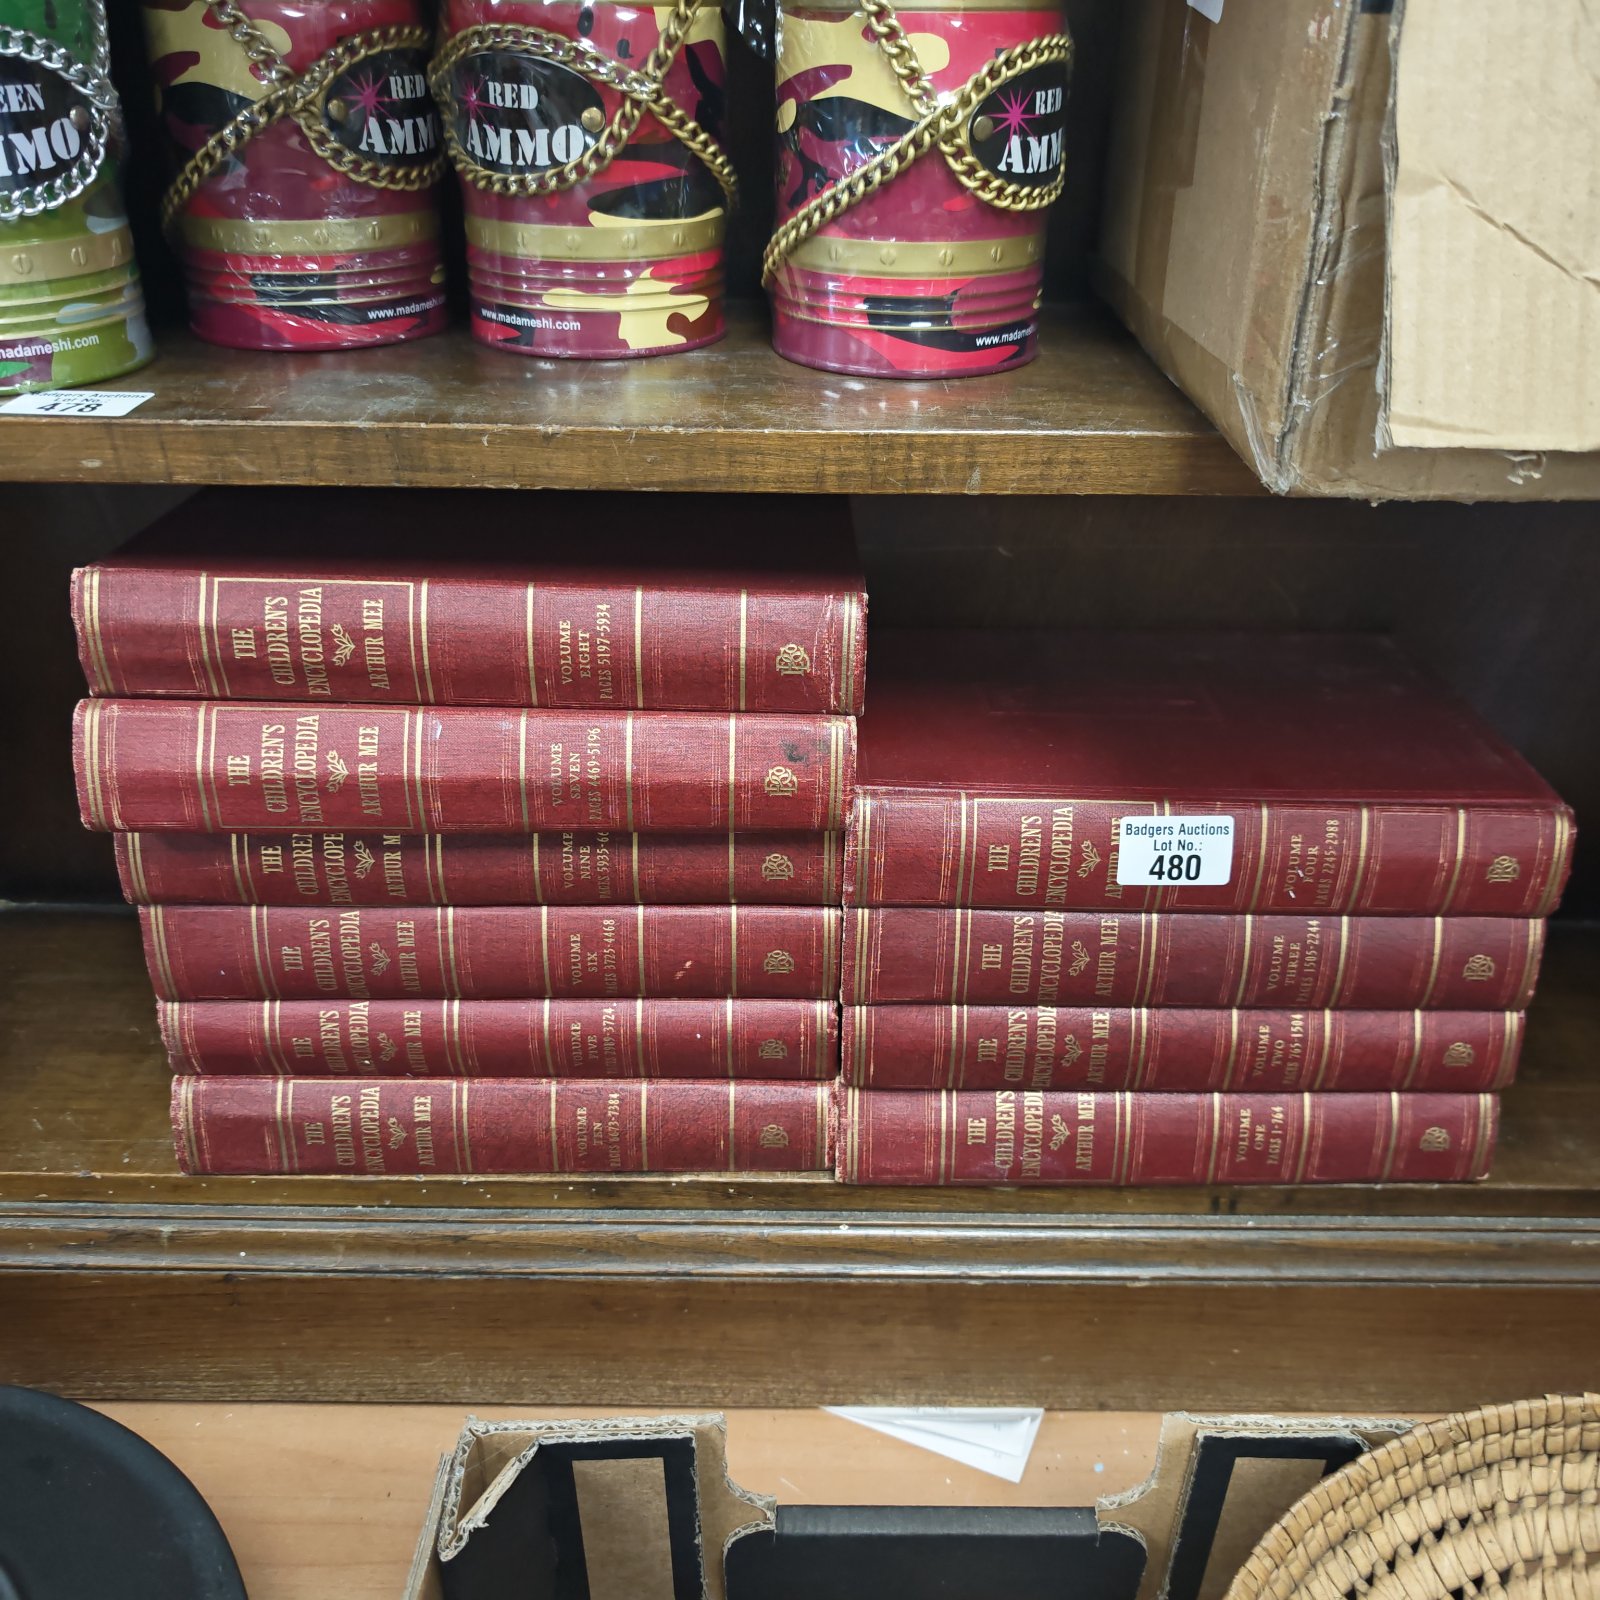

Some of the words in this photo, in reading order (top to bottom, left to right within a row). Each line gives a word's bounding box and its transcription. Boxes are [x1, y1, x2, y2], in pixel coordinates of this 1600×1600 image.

[389, 74, 426, 99] RED
[488, 81, 538, 109] RED
[1036, 88, 1062, 114] RED
[0, 118, 80, 177] MO
[467, 118, 584, 166] AMMO
[481, 308, 580, 330] www.madameshi.com
[36, 403, 102, 412] 478
[364, 599, 383, 630] MEE
[232, 628, 256, 658] THE
[265, 597, 295, 684] CHILDREN'S
[299, 587, 331, 696] ENCYCLOPEDIA
[560, 620, 573, 684] VOLUME
[579, 631, 591, 678] EIGHT
[365, 636, 390, 689] ARTHUR
[599, 670, 612, 699] PAGES
[359, 727, 379, 756] MEE
[228, 755, 251, 786] THE
[261, 725, 288, 812] CHILDREN'S
[295, 715, 323, 823] ENCYCLOPEDIA
[551, 743, 564, 806] VOLUME
[570, 752, 580, 799] SEVEN
[359, 762, 381, 816] ARTHUR
[1126, 824, 1174, 838] Badgers
[1178, 823, 1229, 835] Auctions
[1154, 840, 1172, 851] Lot
[1178, 840, 1202, 851] No.:
[261, 846, 283, 873] THE
[383, 851, 406, 897] ARTHUR
[563, 832, 574, 888] VOLUME
[580, 846, 591, 879] NINE
[988, 845, 1010, 871] THE
[1016, 815, 1042, 896] CHILDREN'S
[1045, 807, 1073, 904] ENCYCLOPEDIA
[1149, 855, 1201, 880] 480
[1284, 834, 1302, 892] VOLUME
[1303, 846, 1319, 883] FOUR
[397, 921, 415, 947] MEE
[1101, 919, 1118, 945] MEE
[282, 946, 304, 971] THE
[309, 920, 338, 991] CHILDREN'S
[400, 952, 421, 991] ARTHUR
[570, 934, 582, 985] VOLUME
[587, 952, 597, 972] SIX
[982, 944, 1002, 970] THE
[1010, 917, 1034, 993] CHILDREN'S
[1095, 951, 1116, 996] ARTHUR
[1267, 935, 1284, 990] VOLUME
[1285, 943, 1300, 986] THREE
[404, 1010, 421, 1037] MEE
[1093, 1011, 1110, 1039] MEE
[572, 1022, 583, 1066] VOLUME
[978, 1039, 998, 1062] THE
[1004, 1011, 1027, 1081] CHILDREN'S
[1087, 1044, 1108, 1083] ARTHUR
[1253, 1025, 1270, 1077] VOLUME
[1271, 1040, 1285, 1066] TWO
[414, 1096, 431, 1122] MEE
[1078, 1093, 1095, 1120] MEE
[305, 1122, 325, 1145] THE
[332, 1095, 356, 1166] CHILDREN'S
[360, 1087, 385, 1172] ENCYCLOPEDIA
[416, 1126, 435, 1166] ARTHUR
[577, 1107, 588, 1157] VOLUME
[594, 1122, 603, 1146] TEN
[968, 1118, 987, 1145] THE
[995, 1091, 1016, 1168] CHILDREN'S
[1076, 1125, 1094, 1171] ARTHUR
[1236, 1108, 1251, 1162] VOLUME
[1254, 1124, 1265, 1150] ONE
